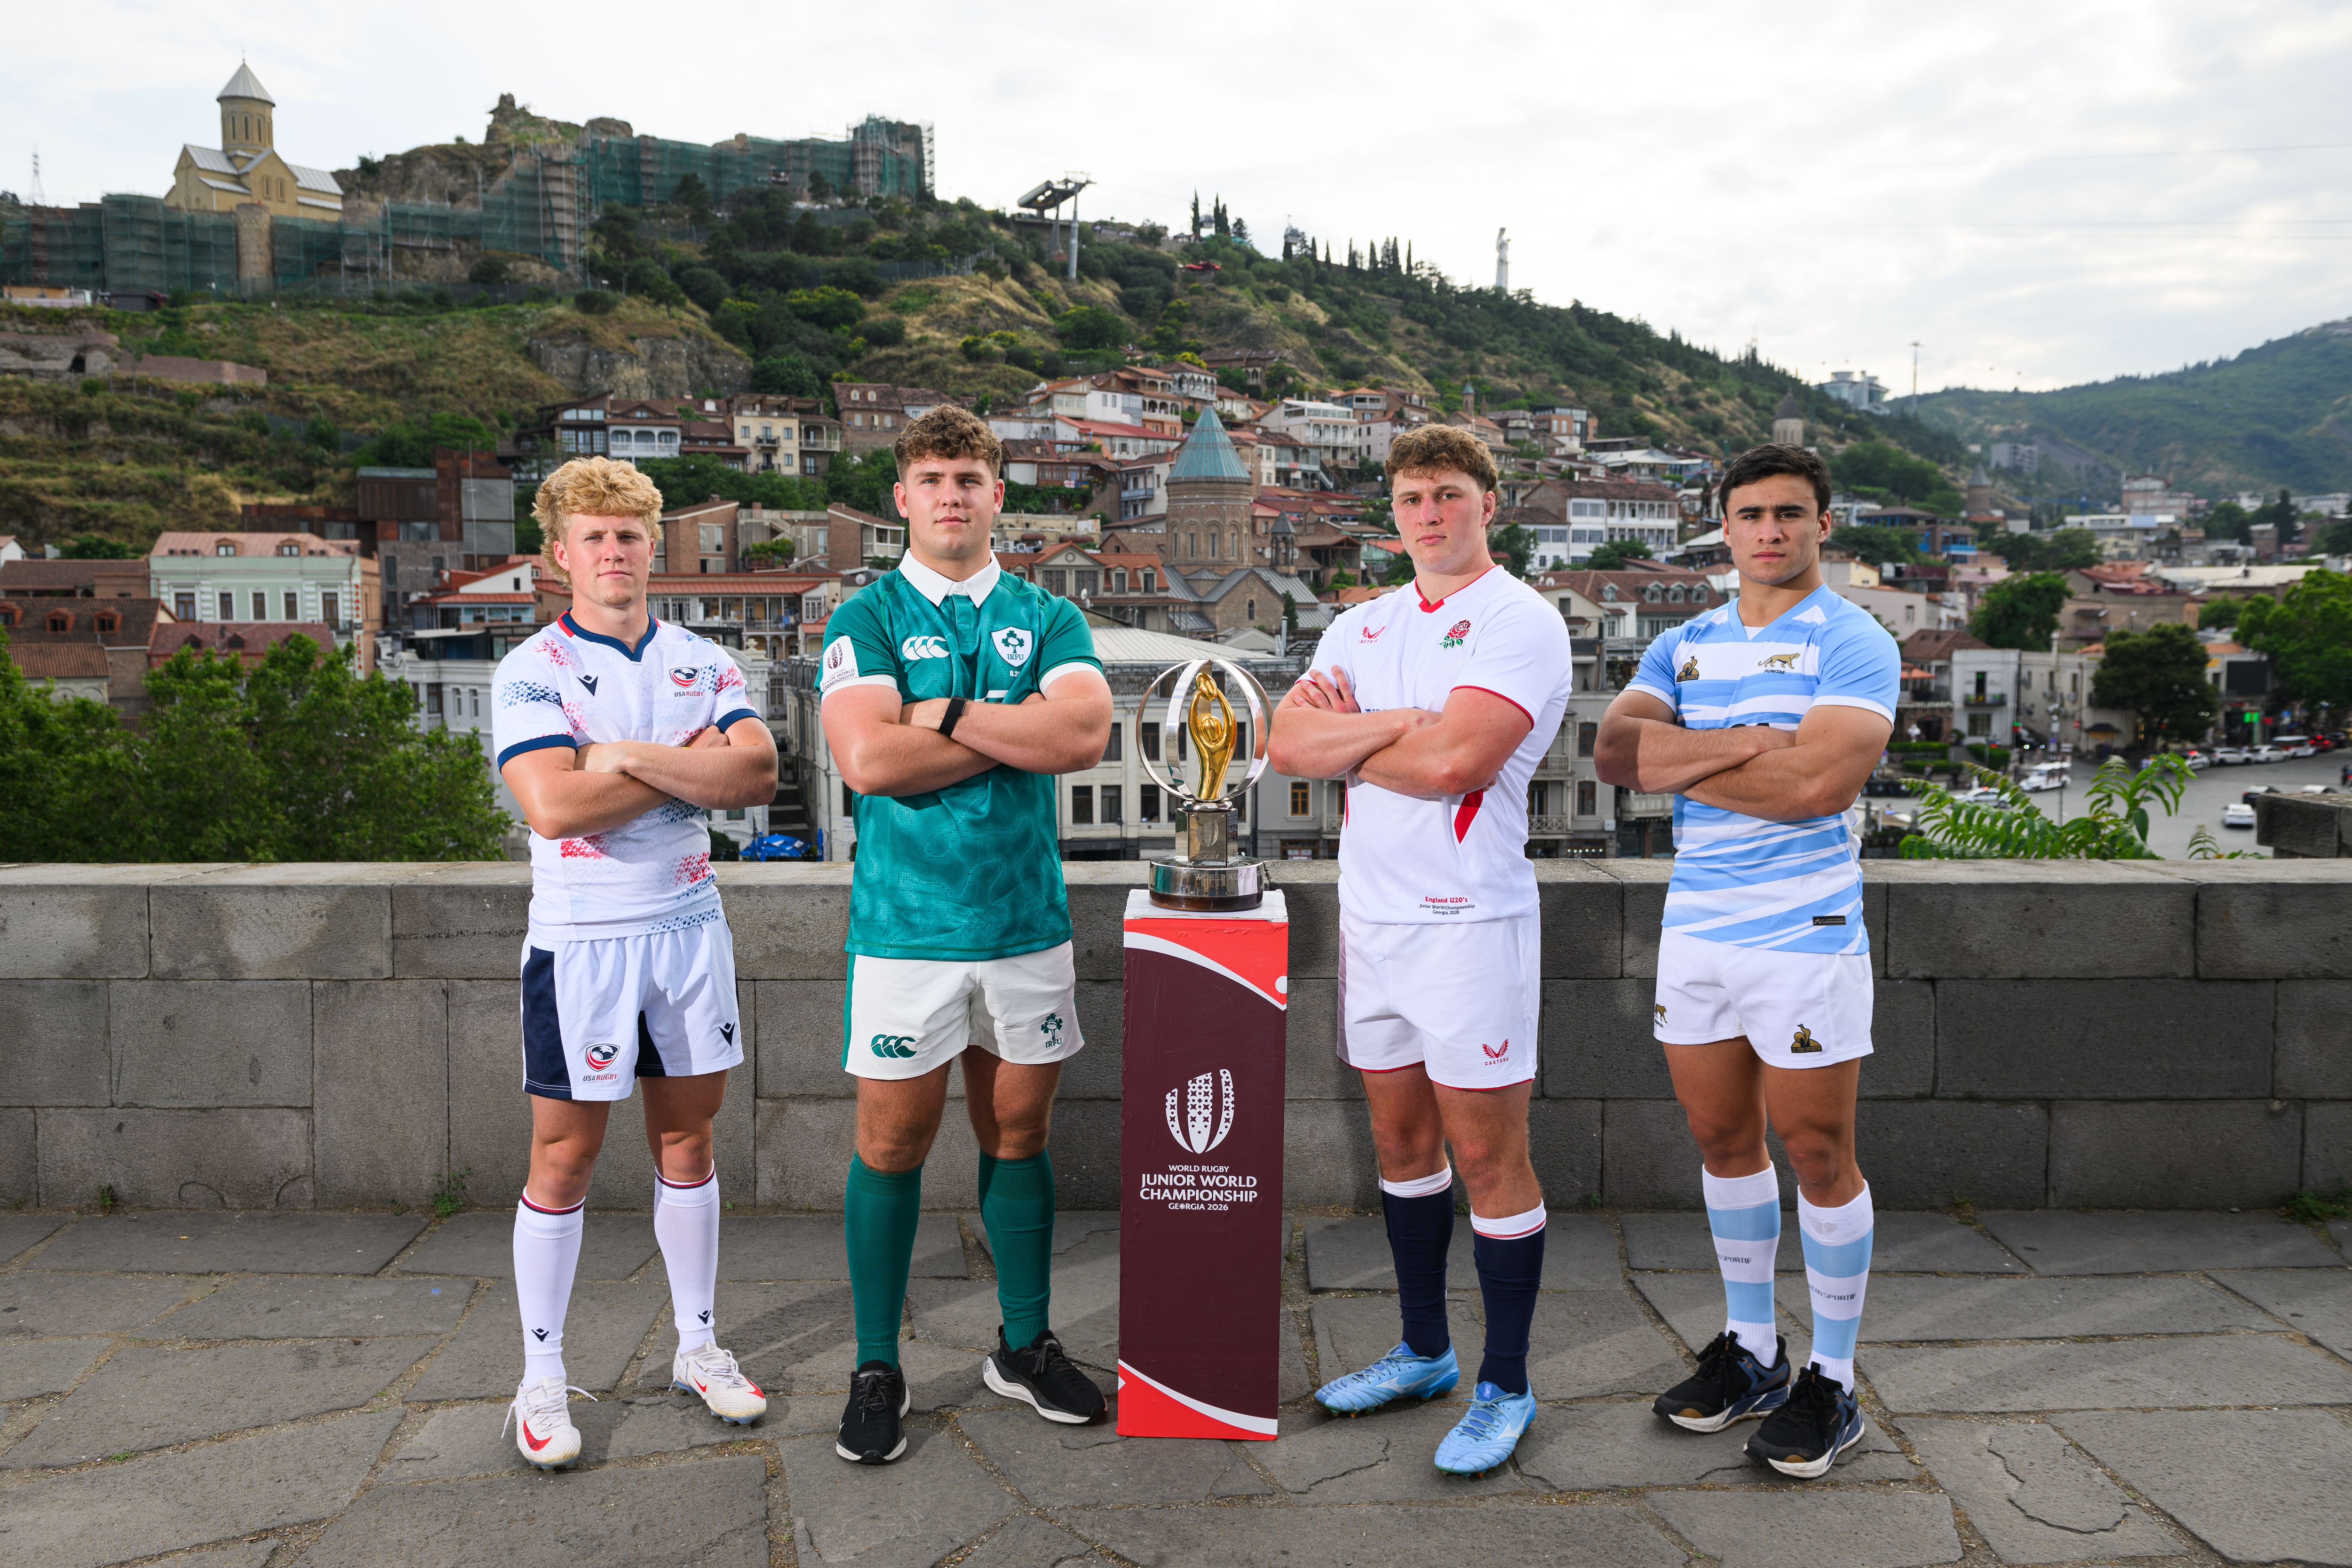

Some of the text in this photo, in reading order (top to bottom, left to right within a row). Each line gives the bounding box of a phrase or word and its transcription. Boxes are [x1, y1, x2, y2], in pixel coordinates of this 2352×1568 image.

[836, 669, 855, 677] WORLD
[822, 672, 856, 691] CHAMPIONSHIP
[1045, 1037, 1062, 1048] IRFU
[1485, 1057, 1509, 1066] CASTORE
[1141, 1173, 1257, 1188] JUNIOR WORLD
[1139, 1188, 1258, 1202] CHAMPIONSHIP
